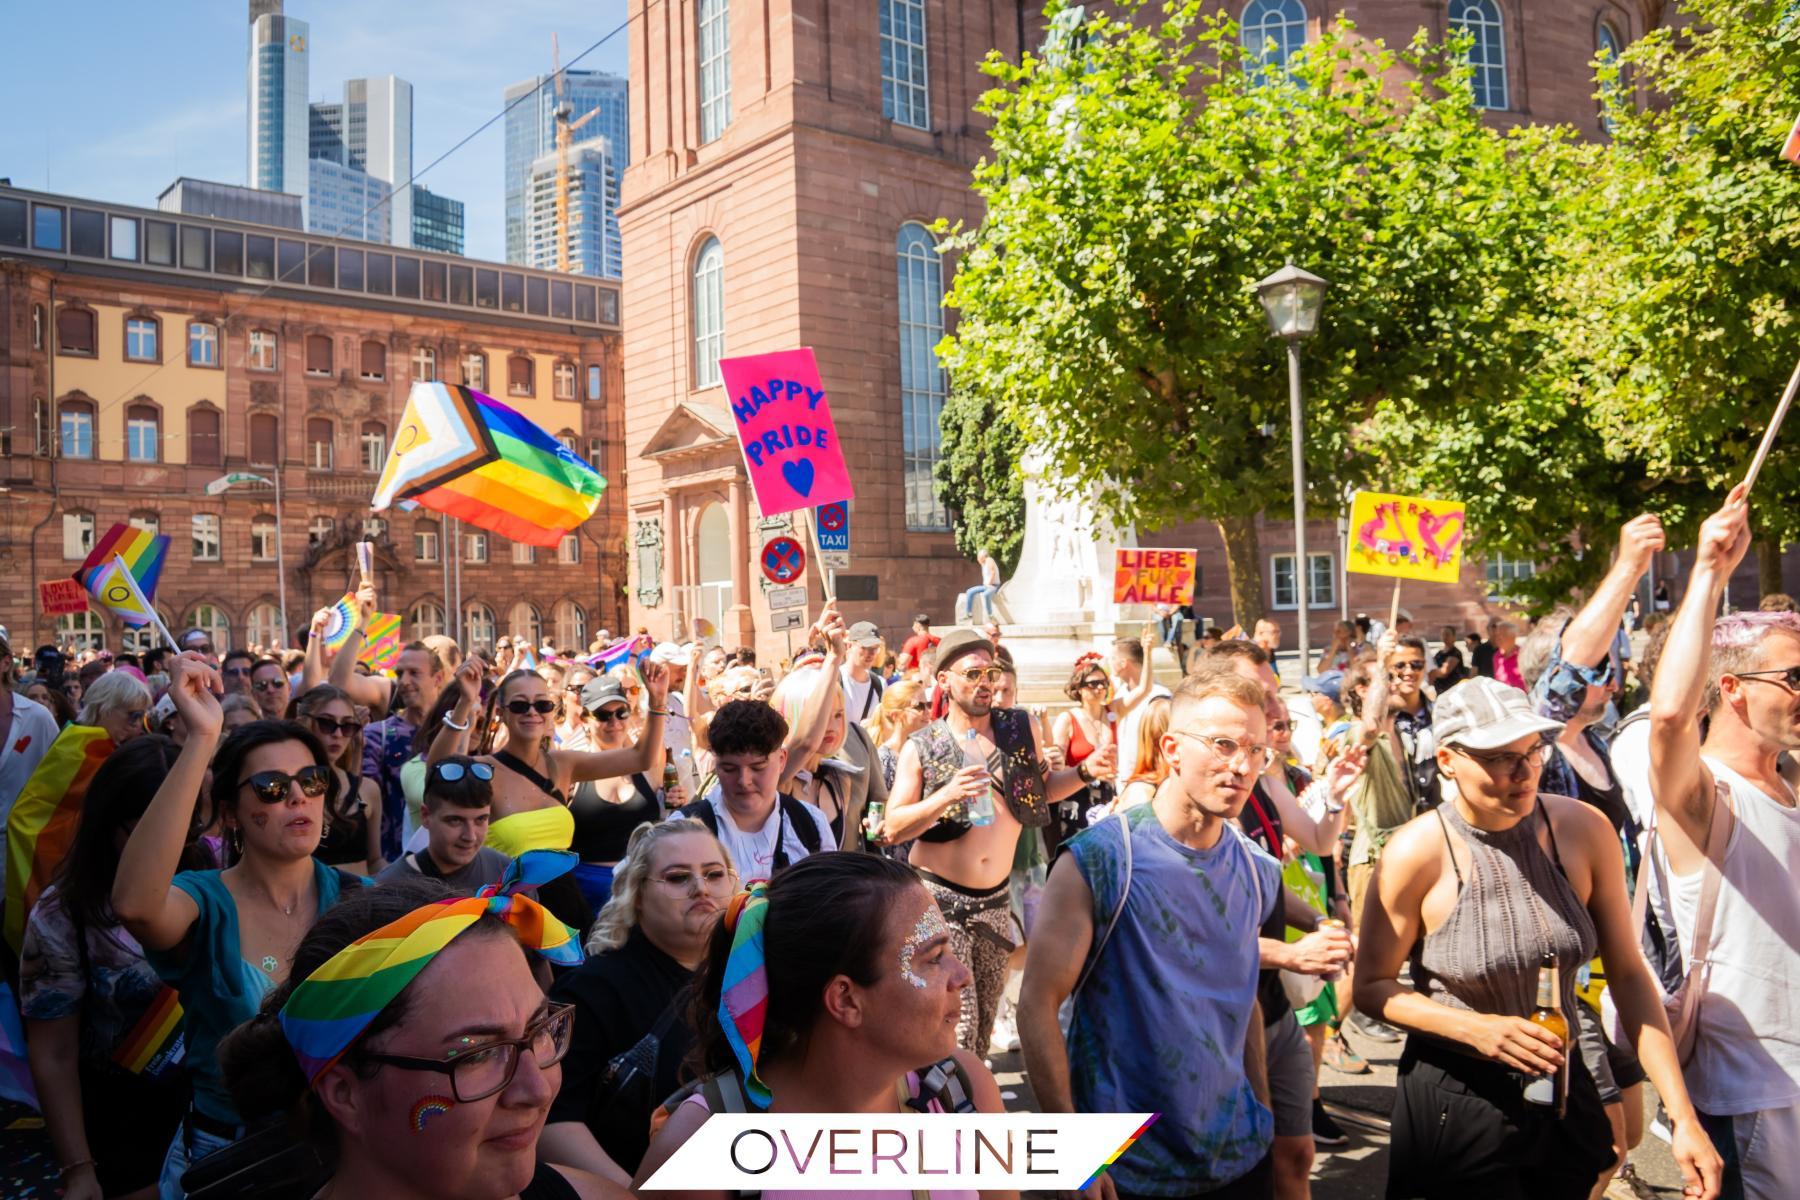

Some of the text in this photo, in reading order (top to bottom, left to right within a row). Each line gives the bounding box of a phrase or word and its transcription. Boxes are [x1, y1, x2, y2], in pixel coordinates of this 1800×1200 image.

[732, 378, 825, 425] HAPPY
[745, 424, 828, 467] PRIDE
[821, 534, 846, 546] TAXI
[1121, 550, 1186, 568] LIEBE
[1122, 583, 1184, 605] ALLE
